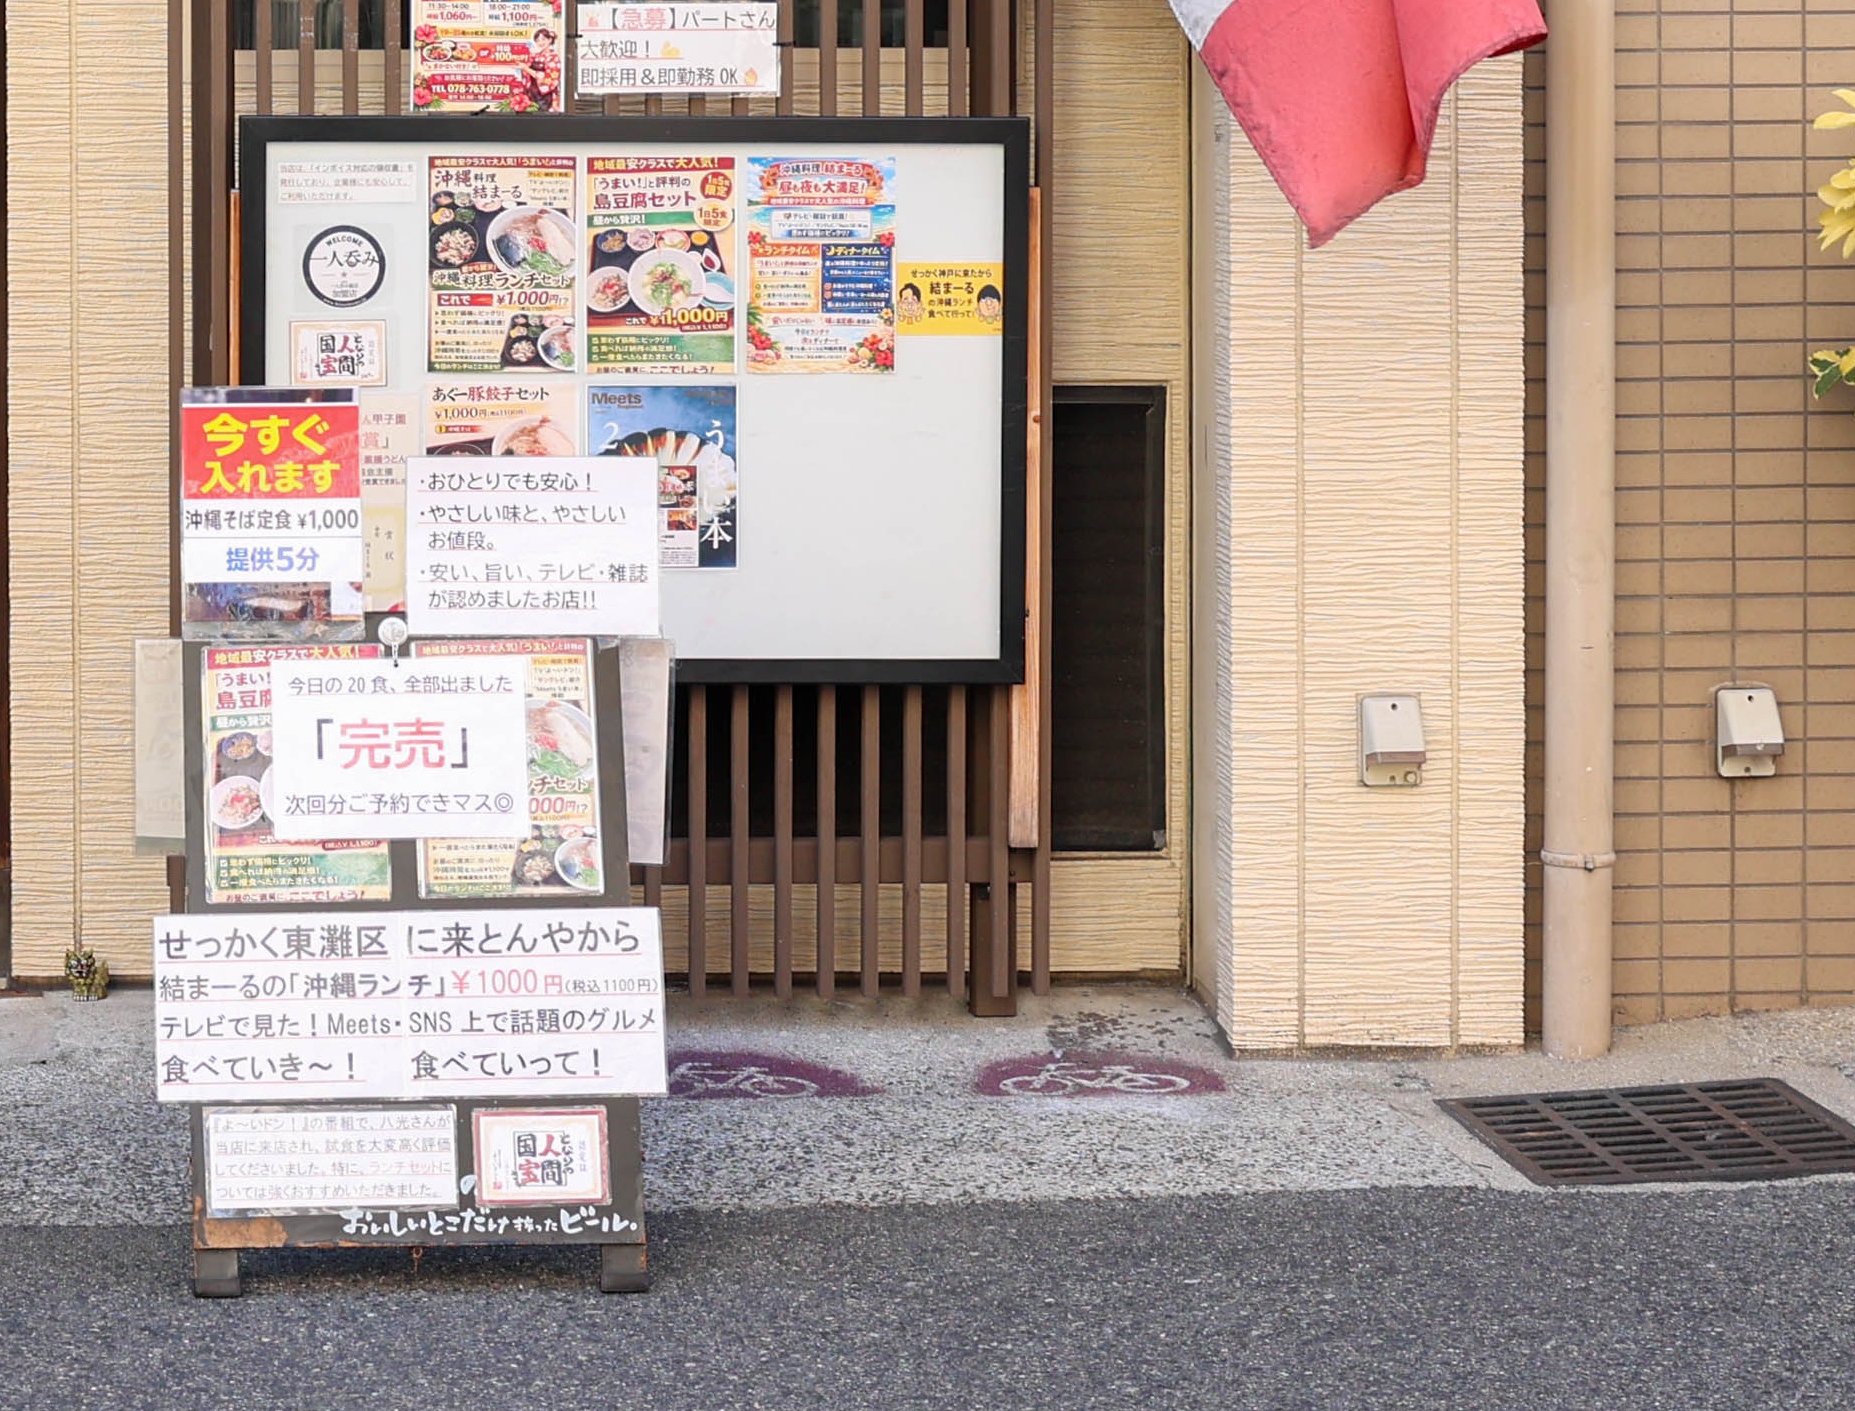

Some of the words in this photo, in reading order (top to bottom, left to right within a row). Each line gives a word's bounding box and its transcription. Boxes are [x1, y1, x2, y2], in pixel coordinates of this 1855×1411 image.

[611, 7, 776, 29] 【急募】パートさん
[580, 39, 650, 59] 大歓迎！
[431, 85, 446, 93] TEL
[447, 83, 510, 94] 078-763-0778
[593, 191, 697, 209] 島豆腐セット
[325, 235, 363, 247] WELCOME
[910, 268, 993, 279] せっかく神戸に来たから
[929, 281, 975, 295] 結まーる
[440, 295, 471, 305] これで
[431, 385, 550, 403] あぐー豚餃子セット
[591, 392, 643, 405] Meets
[202, 412, 330, 457] 今すぐ
[200, 460, 341, 494] 入れます
[185, 509, 291, 531] 沖縄そば定食
[428, 530, 495, 550] お値段。
[225, 546, 320, 572] 提供5分
[316, 717, 470, 770] 「完売」
[529, 776, 587, 794] チセット
[158, 925, 390, 961] せっかく東灘区
[406, 921, 641, 955] に来とんやから
